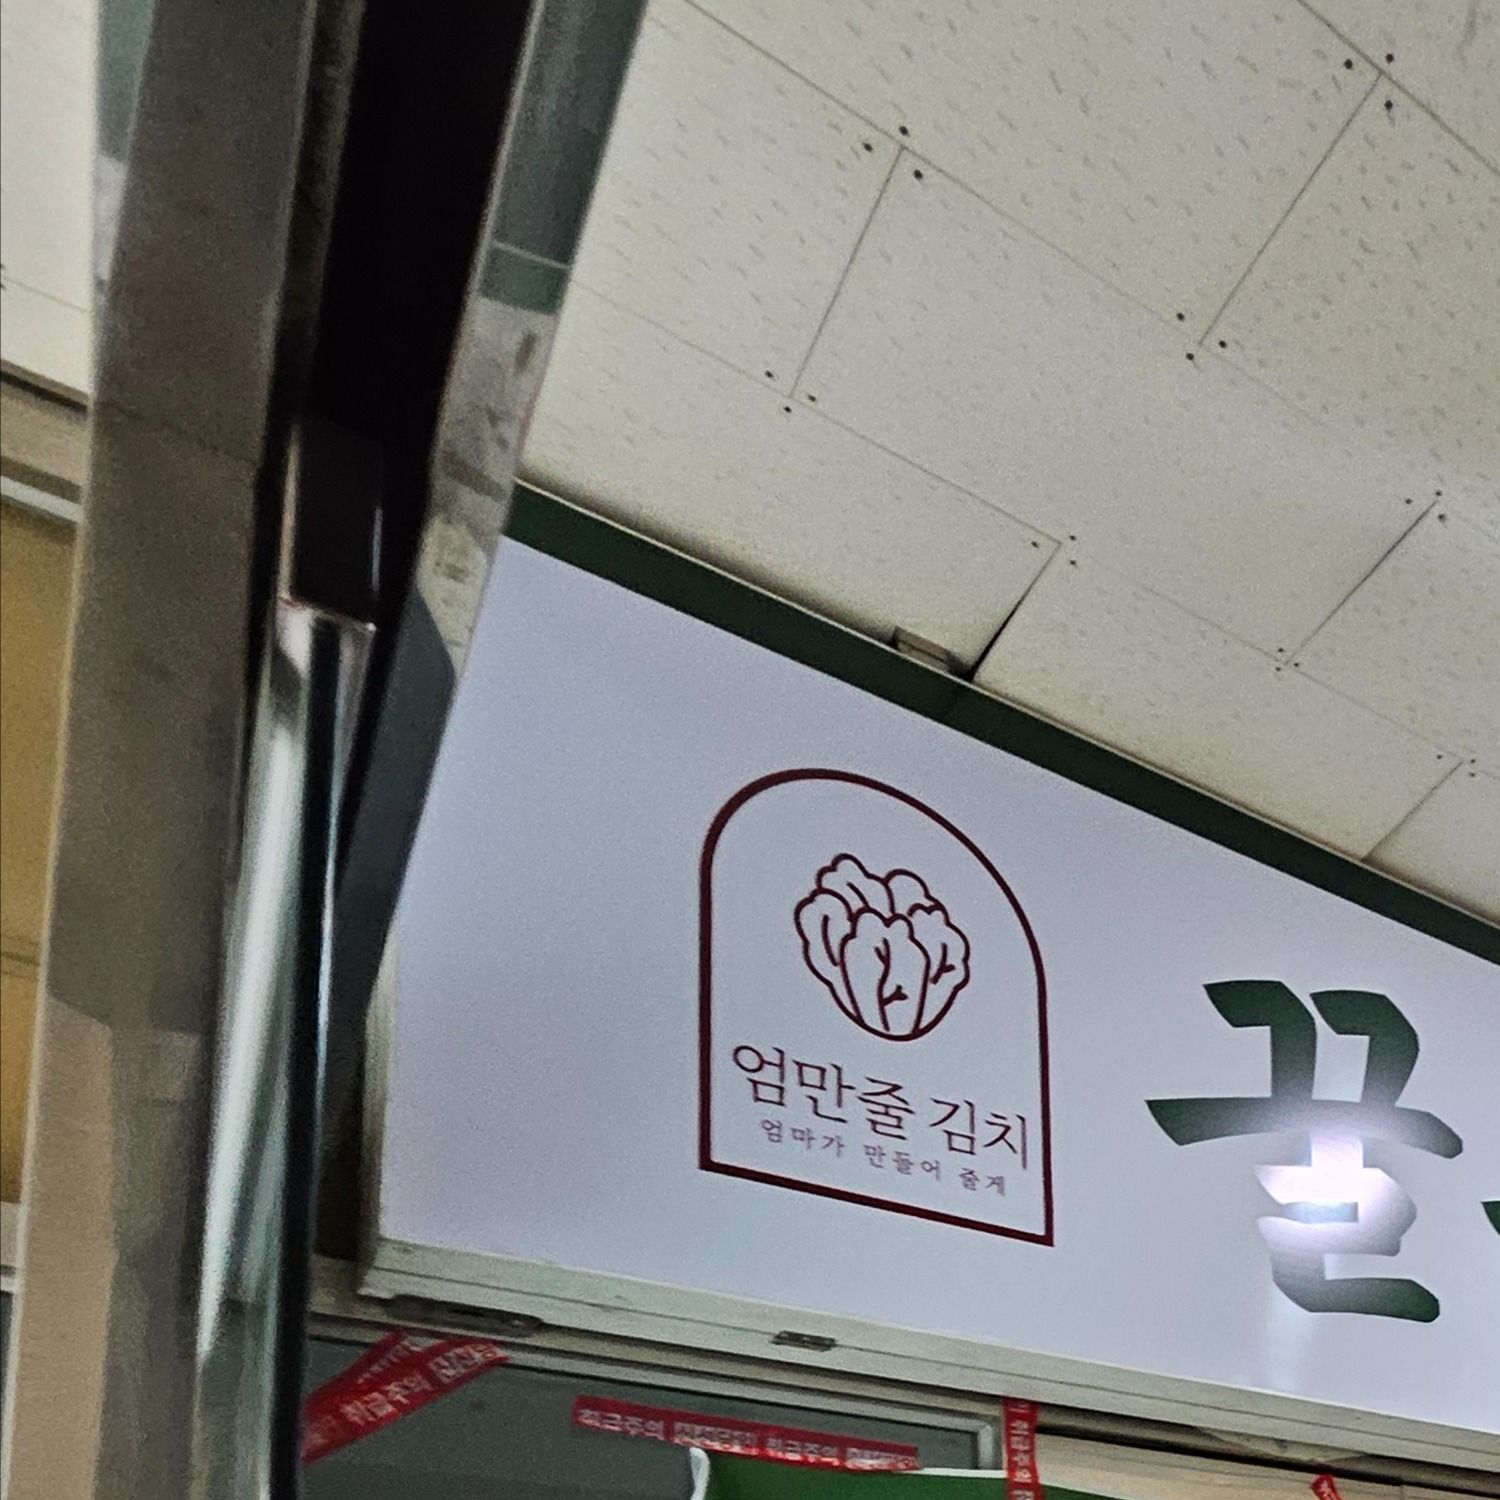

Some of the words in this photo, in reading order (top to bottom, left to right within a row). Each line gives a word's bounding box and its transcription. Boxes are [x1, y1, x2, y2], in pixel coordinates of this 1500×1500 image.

[732, 1044, 916, 1141] 엄만줄
[929, 1097, 1028, 1171] 김치
[760, 1117, 845, 1159] 엄마가
[863, 1143, 940, 1182] 만들어
